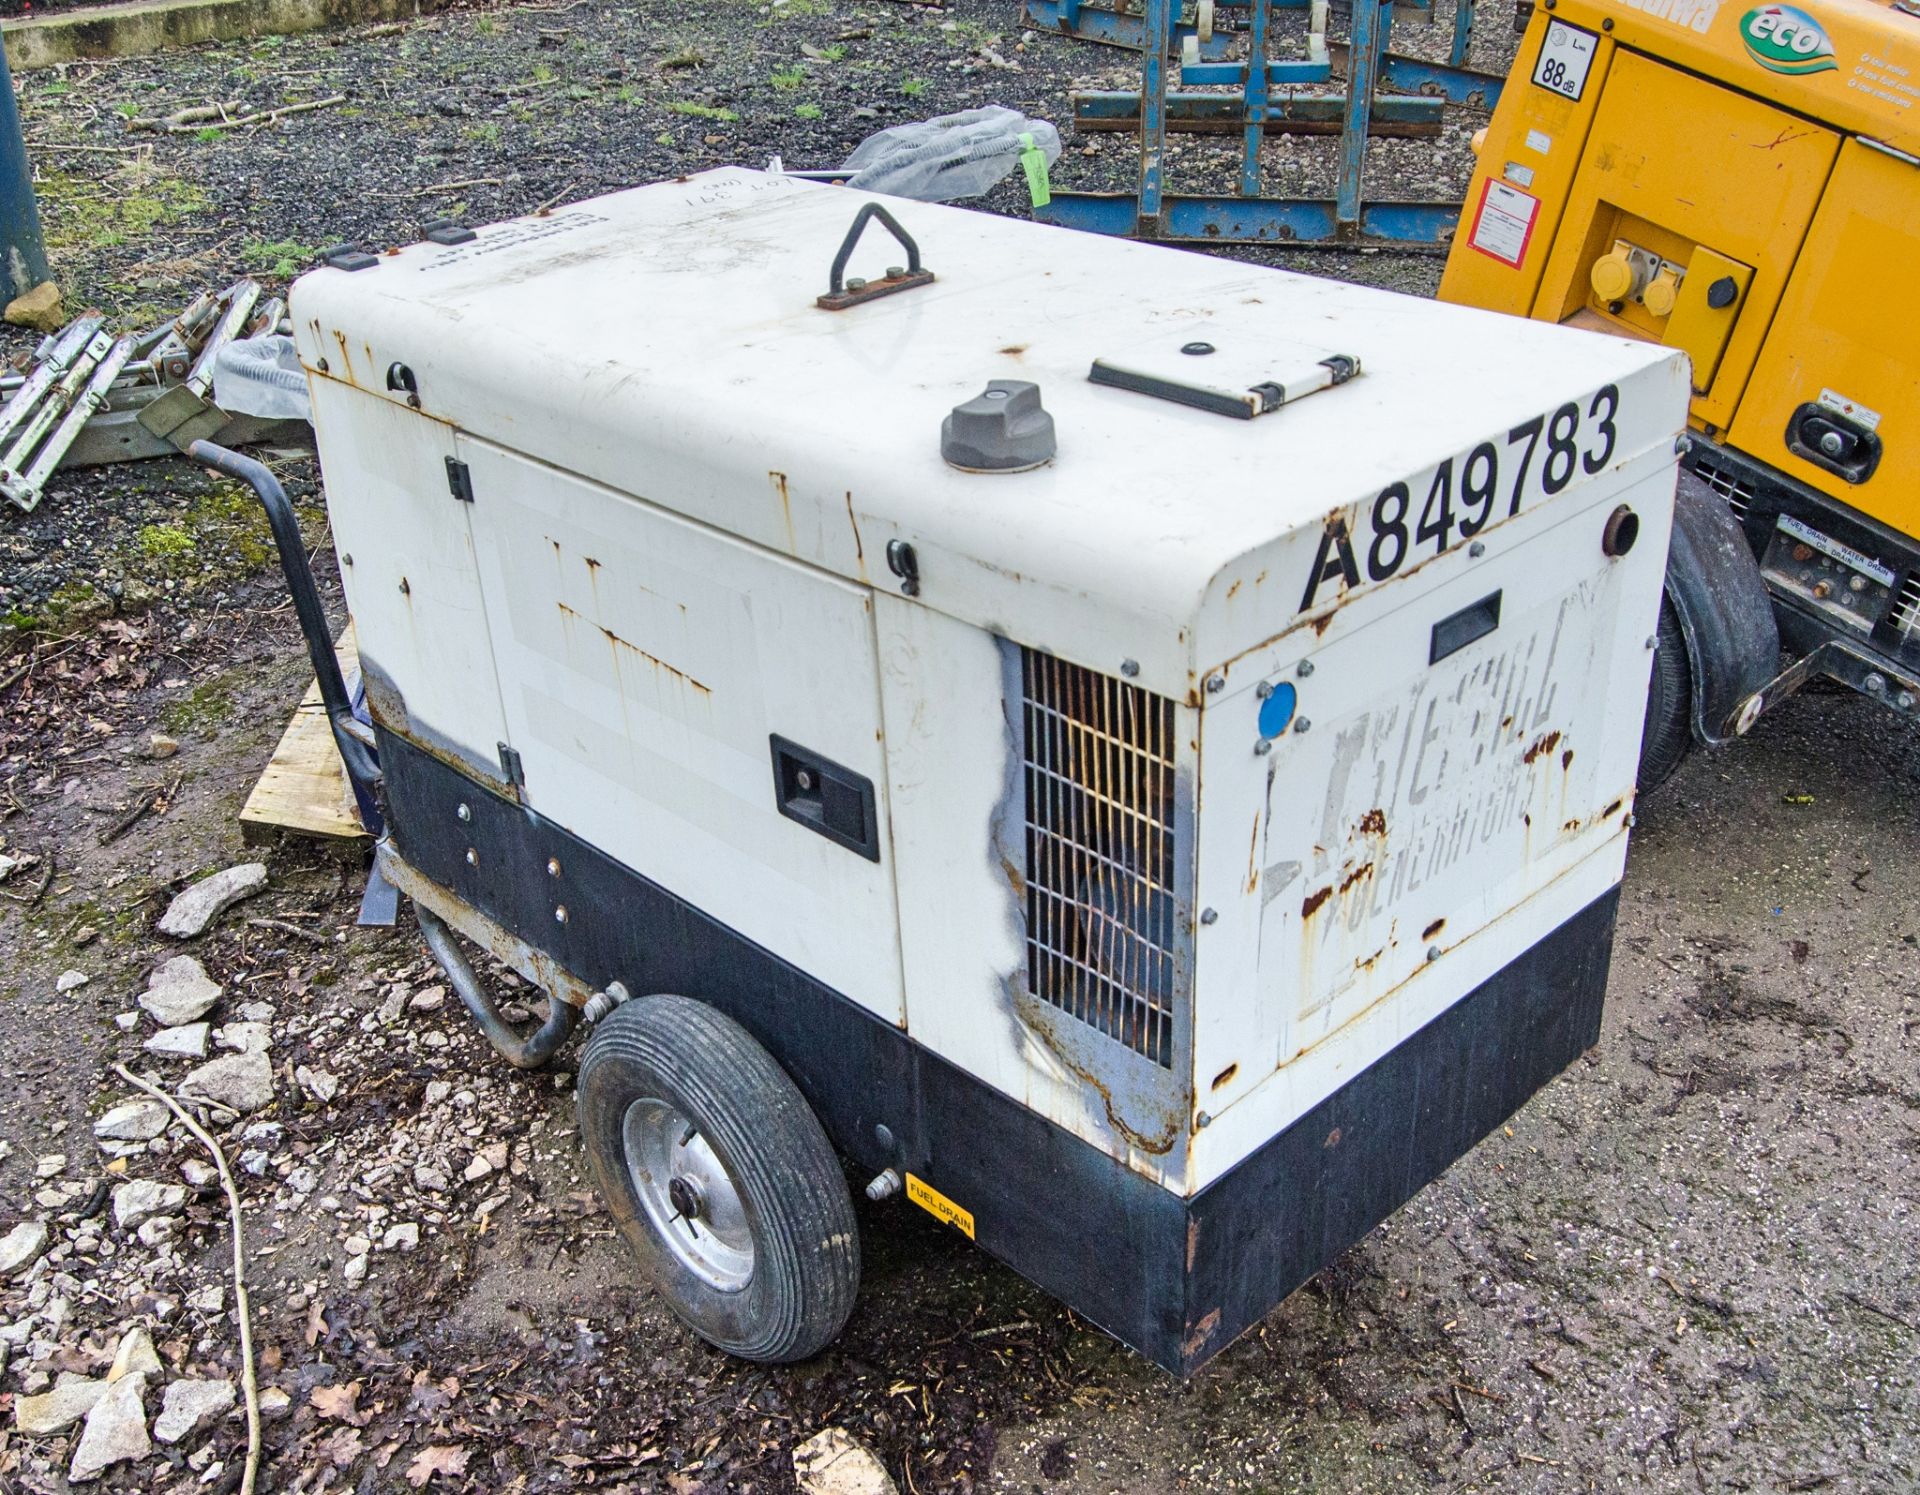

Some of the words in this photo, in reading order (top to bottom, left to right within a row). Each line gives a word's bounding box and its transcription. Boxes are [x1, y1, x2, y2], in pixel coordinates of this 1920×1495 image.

[1542, 58, 1566, 87] 88
[1563, 80, 1576, 93] dB
[1297, 383, 1620, 615] A849783
[1787, 518, 1803, 532] FUEL
[1807, 528, 1828, 543] DRAIN
[1840, 545, 1865, 563] WATER
[1867, 561, 1889, 576] DRAIN
[1816, 541, 1827, 551] OIL
[1831, 550, 1852, 564] DRAIN
[910, 1183, 937, 1208] FUEL
[939, 1203, 971, 1231] DRAIN
